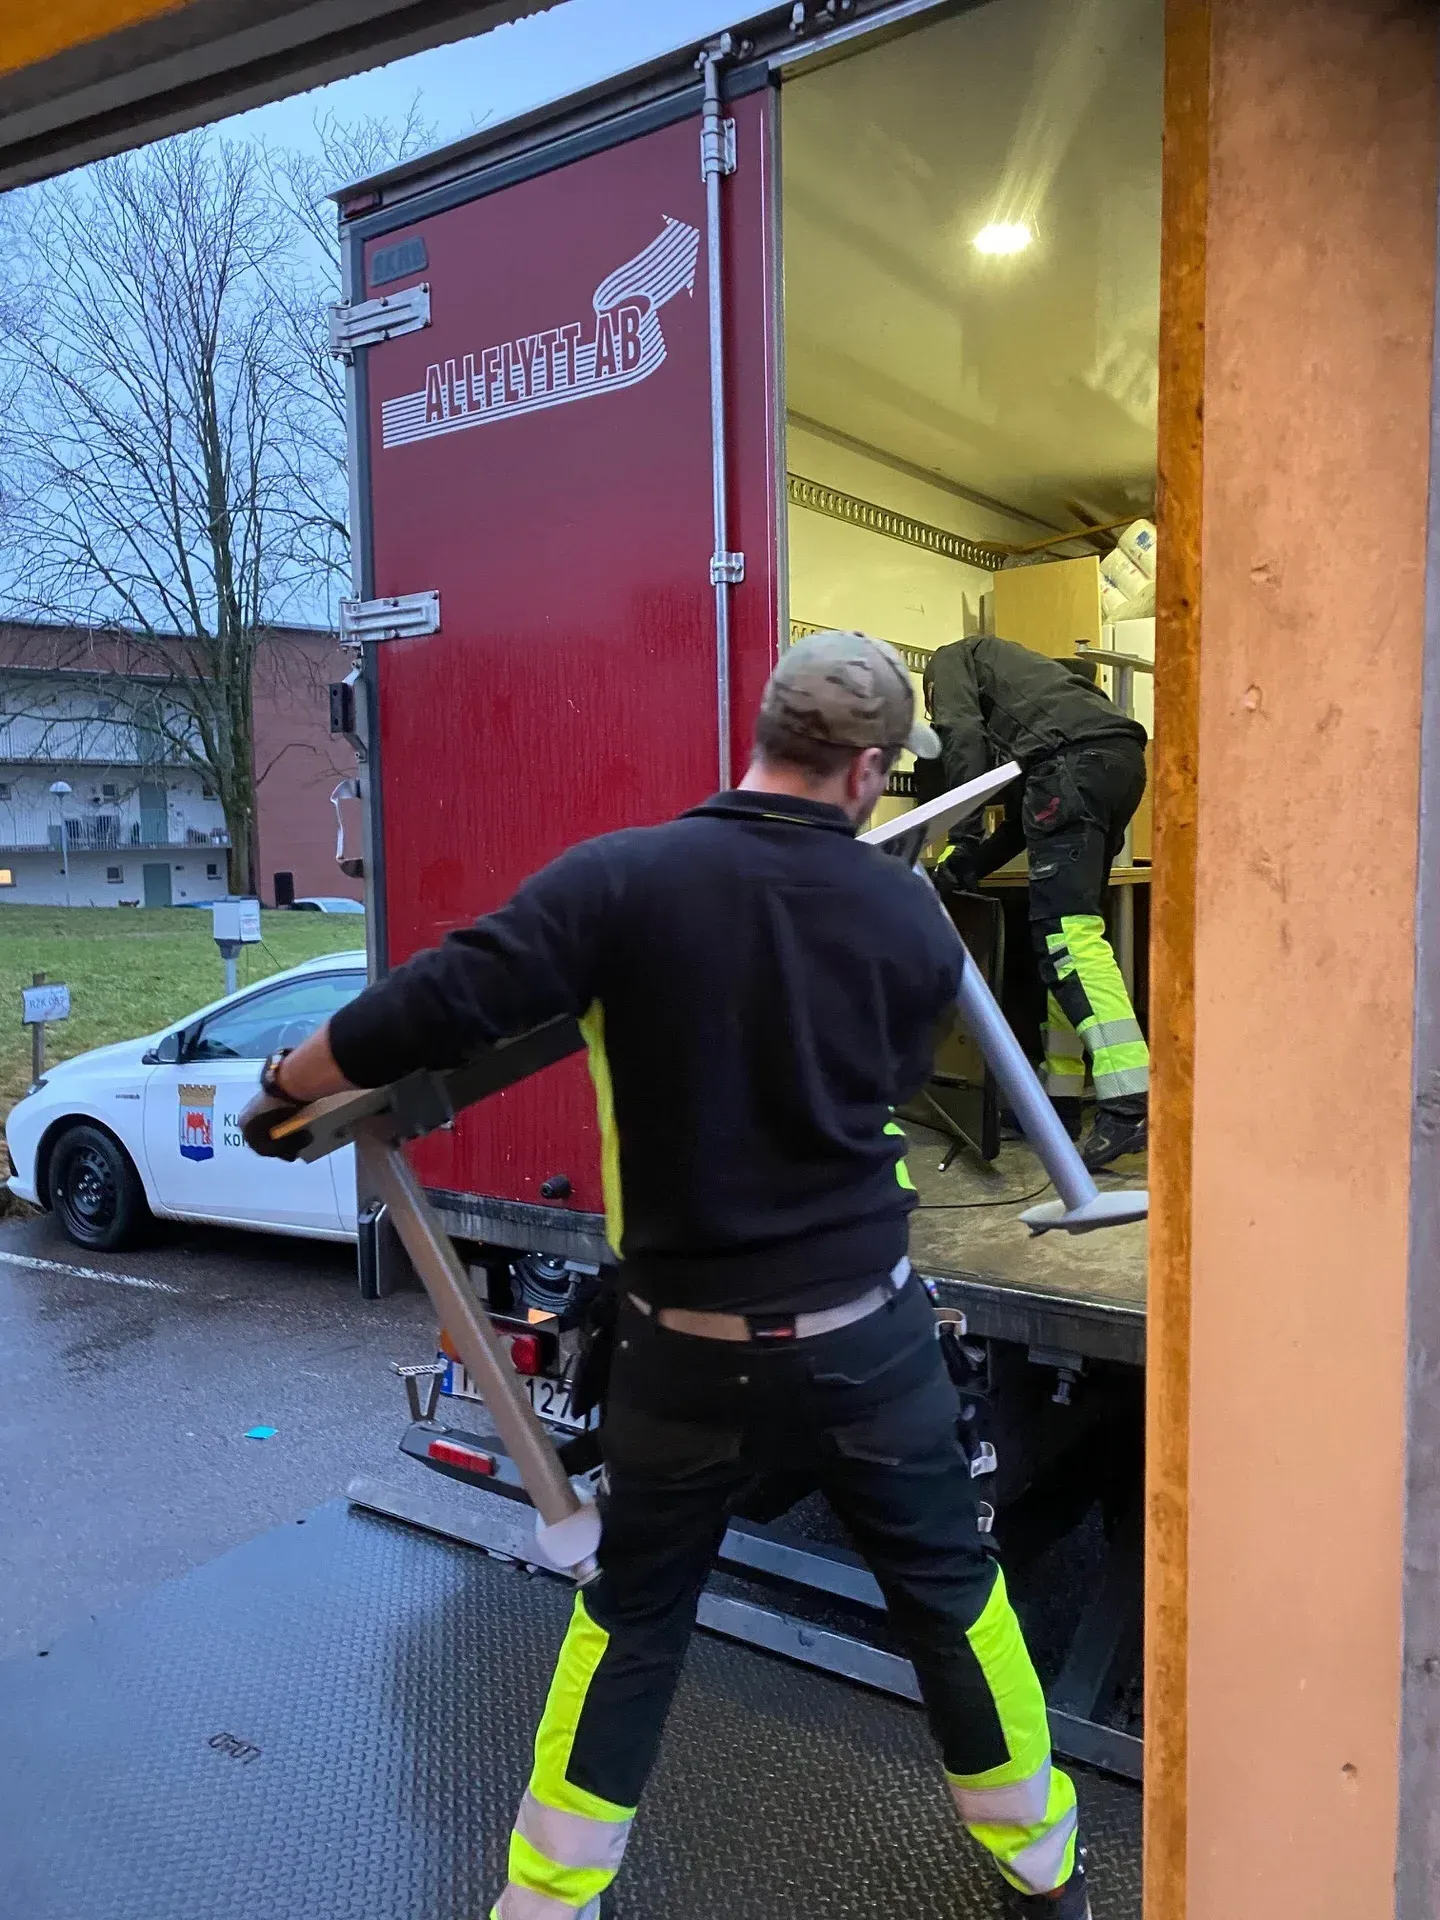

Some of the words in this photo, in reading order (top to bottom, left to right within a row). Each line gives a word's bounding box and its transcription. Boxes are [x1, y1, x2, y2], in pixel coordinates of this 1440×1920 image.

[424, 322, 582, 424] ALLFLYTT
[594, 305, 643, 379] AB
[224, 1112, 240, 1127] KU
